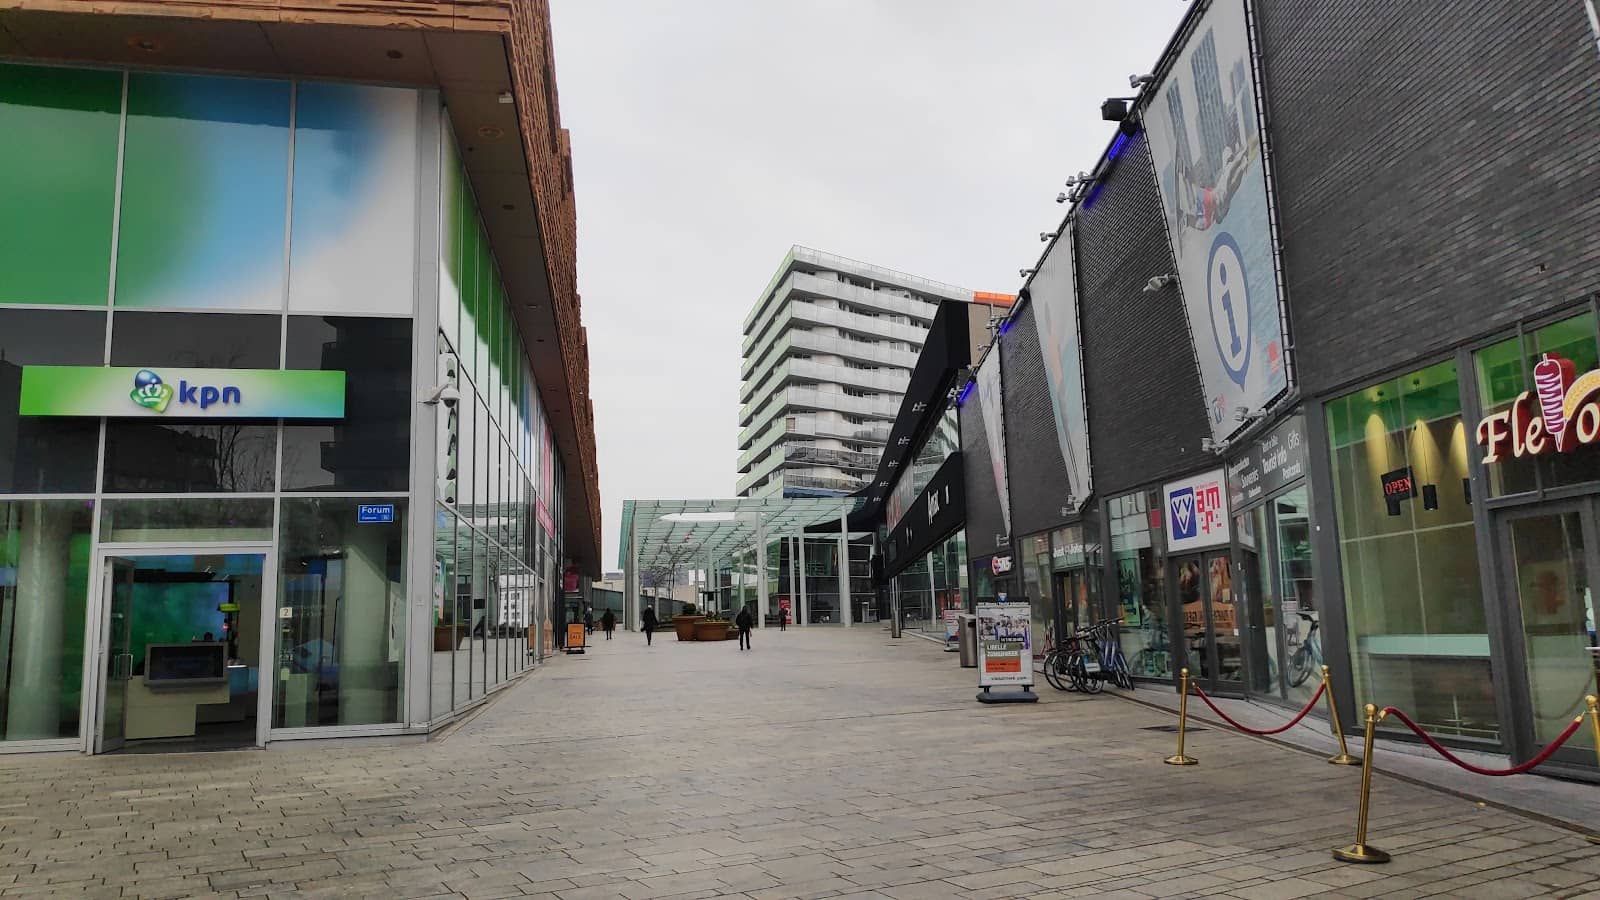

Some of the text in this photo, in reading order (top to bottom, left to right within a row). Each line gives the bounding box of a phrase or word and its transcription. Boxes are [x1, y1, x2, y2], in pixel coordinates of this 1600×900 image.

[178, 380, 241, 410] kpn
[1385, 477, 1411, 495] OPEN
[361, 506, 390, 514] Forum
